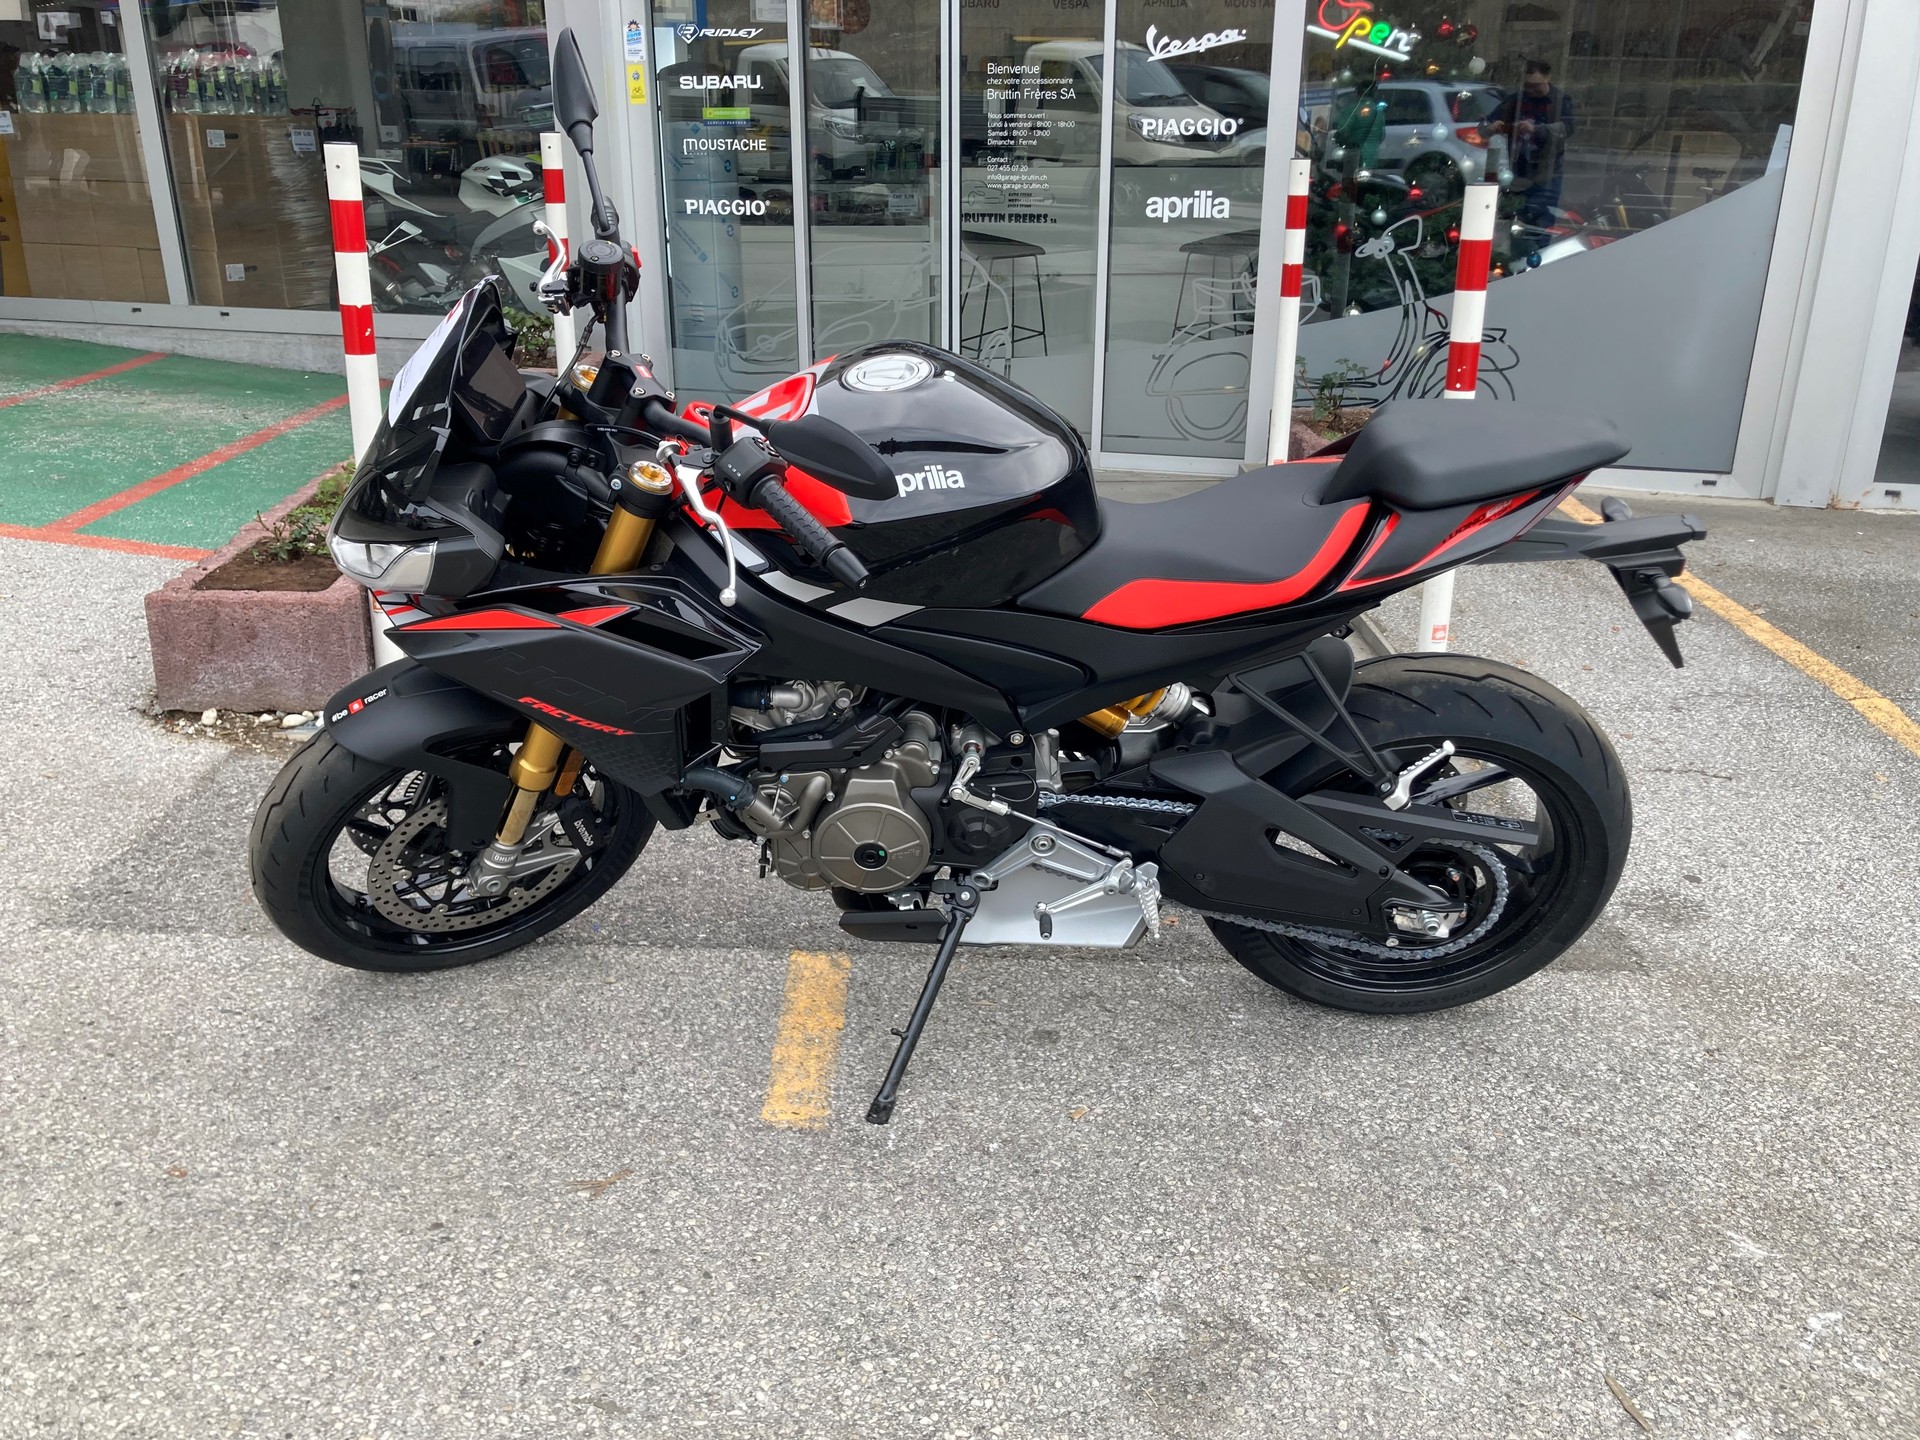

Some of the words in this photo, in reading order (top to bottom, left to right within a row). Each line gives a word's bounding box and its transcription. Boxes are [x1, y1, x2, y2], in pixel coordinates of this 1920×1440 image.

[961, 0, 999, 8] UBARU
[1054, 0, 1089, 9] VESPA
[1143, 0, 1188, 8] APRILIA
[1317, 0, 1411, 52] Open
[698, 28, 764, 39] RIDLEY
[1146, 24, 1247, 62] Vespa
[987, 62, 1040, 75] Bienvenue
[986, 77, 1002, 85] chez
[1003, 77, 1020, 85] votre
[1021, 77, 1074, 85] concessionnaire
[987, 88, 1021, 100] Bruttin
[1023, 88, 1057, 100] Frères
[1060, 88, 1076, 100] SA
[683, 138, 767, 155] MOUSTACHE
[987, 138, 1015, 146] Dimanche
[1019, 138, 1038, 146] Fermé
[987, 173, 1048, 182] info@garage-bruttin.ch
[987, 182, 1050, 190] www.garage-bruttin.ch
[1145, 190, 1230, 223] aprilia
[1008, 213, 1049, 223] FRERES
[895, 464, 966, 498] prilia
[363, 688, 387, 704] racer
[518, 696, 636, 736] FACTORY
[573, 818, 594, 847] brembo
